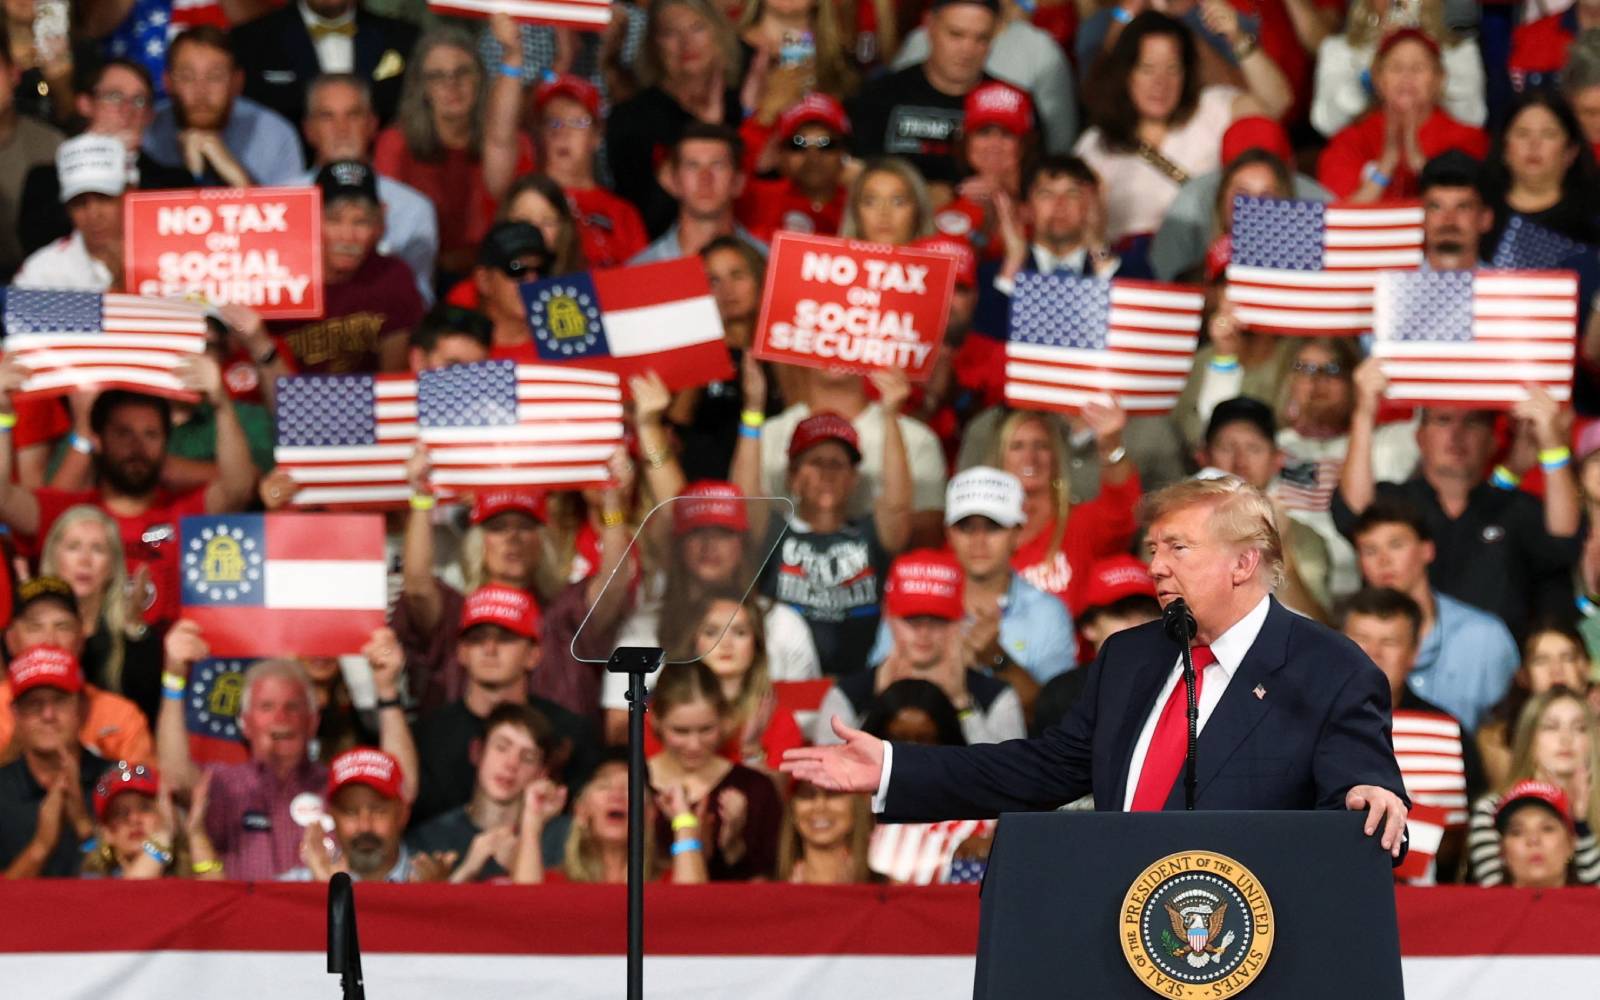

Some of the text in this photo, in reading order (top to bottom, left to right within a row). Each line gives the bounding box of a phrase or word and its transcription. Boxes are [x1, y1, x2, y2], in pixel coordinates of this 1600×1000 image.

[157, 203, 288, 236] NO TAX
[205, 232, 240, 251] ON
[158, 250, 290, 282] SOCIAL
[801, 251, 928, 295] NO TAX
[846, 286, 881, 307] ON
[794, 299, 920, 342] SOCIAL
[769, 321, 932, 368] SECURITY
[1125, 856, 1269, 997] SEAL OF THE PRESIDENT OF THE UNITED STATES
